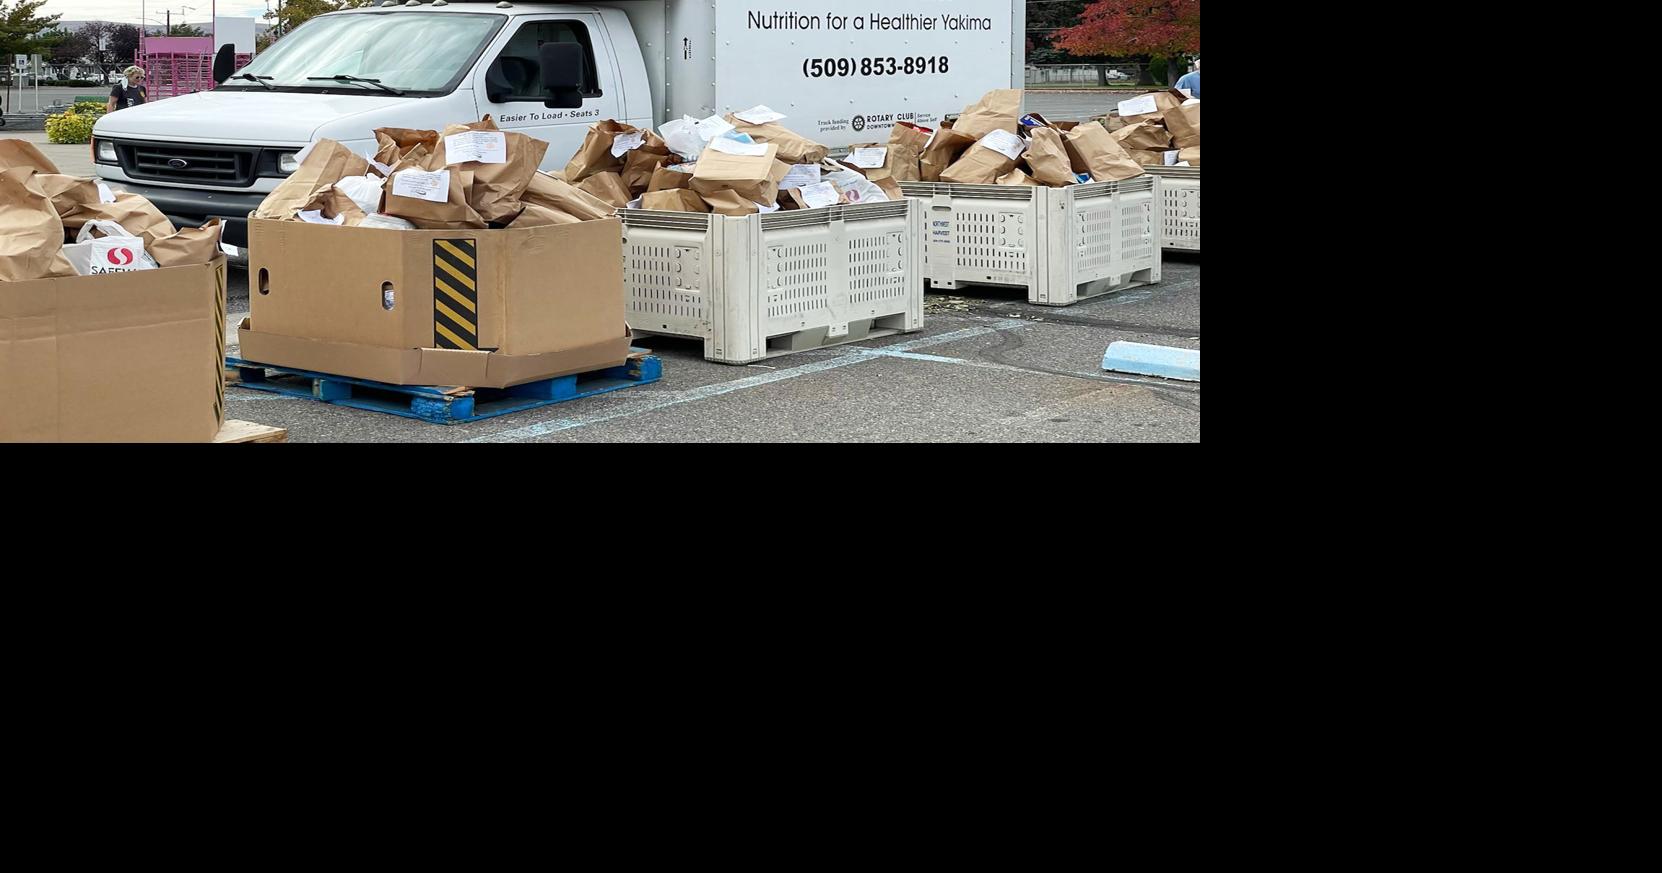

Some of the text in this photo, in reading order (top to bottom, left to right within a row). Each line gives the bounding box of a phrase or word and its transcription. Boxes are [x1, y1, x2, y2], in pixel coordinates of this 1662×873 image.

[748, 10, 991, 30] Nutrition for a Healthier Yakima
[803, 56, 949, 77] (509) 853-8918
[500, 114, 527, 122] Easier
[542, 112, 563, 120] Load
[570, 110, 593, 118] Seats
[867, 112, 914, 122] ROTARY CLUB
